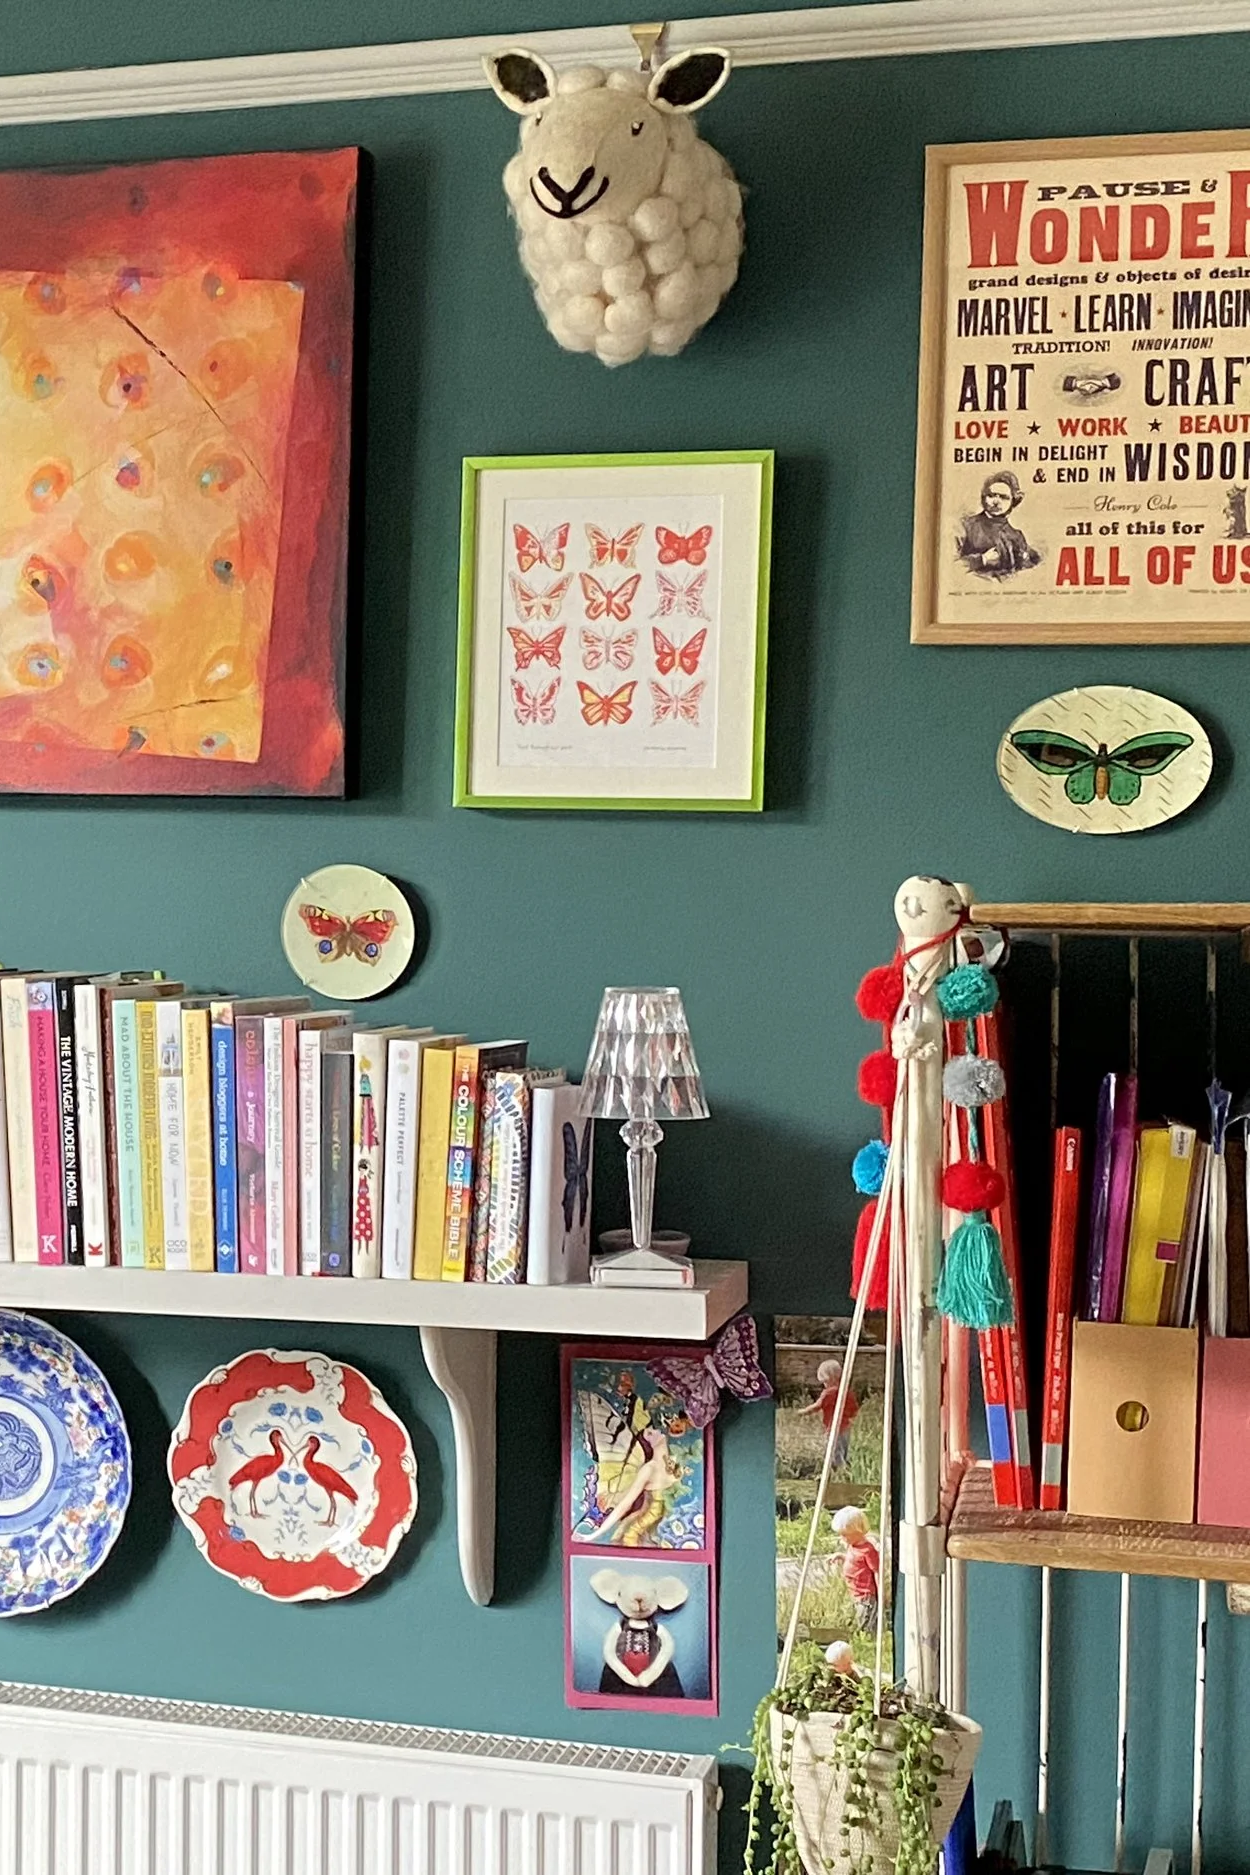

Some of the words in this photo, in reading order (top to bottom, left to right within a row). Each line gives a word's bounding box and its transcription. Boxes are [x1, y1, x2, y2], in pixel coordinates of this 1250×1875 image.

[1037, 179, 1191, 202] PAUSE
[1200, 178, 1218, 193] &
[968, 273, 1019, 291] grand
[1025, 272, 1088, 288] designs
[1095, 271, 1109, 283] &
[1115, 269, 1177, 286] objects
[1183, 267, 1201, 280] of
[957, 296, 1053, 337] MARVEL
[1074, 292, 1152, 333] LEARN
[1012, 340, 1110, 355] TRADITION!
[1131, 337, 1214, 351] INNOVATION!
[957, 363, 1035, 412] ART
[954, 420, 1009, 440] LOVE
[1057, 417, 1128, 437] WORK
[953, 447, 1002, 464] BEGIN
[1012, 446, 1028, 462] IN
[1038, 445, 1108, 461] DELIGHT
[1033, 468, 1047, 483] &
[1057, 467, 1089, 483] END
[1100, 467, 1116, 482] IN
[1093, 494, 1142, 513] Henry
[1146, 495, 1179, 510] Cole
[1065, 522, 1093, 536] all
[1099, 522, 1119, 536] of
[1126, 521, 1166, 535] this
[1172, 521, 1205, 535] for
[1055, 546, 1130, 586] ALL
[1146, 545, 1195, 585] OF
[37, 1016, 47, 1057] MAKING
[120, 1016, 129, 1042] MAD
[38, 1058, 48, 1066] A
[60, 1036, 72, 1057] THE
[217, 1040, 228, 1075] design
[121, 1045, 131, 1084] ABOUT
[300, 1043, 318, 1085] happy
[461, 1064, 470, 1082] THE
[39, 1068, 48, 1103] HOUSE
[123, 1088, 133, 1110] THE
[166, 1082, 178, 1111] HOME
[216, 1078, 229, 1122] bloggers
[40, 1106, 49, 1133] YOUR
[305, 1087, 315, 1123] starts
[397, 1092, 406, 1127] PALETTE
[454, 1085, 470, 1147] COLOUR
[125, 1113, 135, 1152] HOUSE
[168, 1117, 179, 1137] FOR
[219, 1124, 228, 1135] at
[246, 1101, 257, 1144] journey
[41, 1136, 51, 1166] HOME
[63, 1116, 76, 1169] MODERN
[168, 1143, 180, 1166] NOW
[219, 1136, 229, 1166] home
[396, 1130, 405, 1166] PERFECT
[1065, 1138, 1076, 1171] Canon
[305, 1141, 318, 1177] home
[66, 1171, 78, 1207] HOME
[450, 1149, 466, 1213] SCHEME
[41, 1235, 58, 1253] K
[447, 1216, 462, 1258] BIBLE
